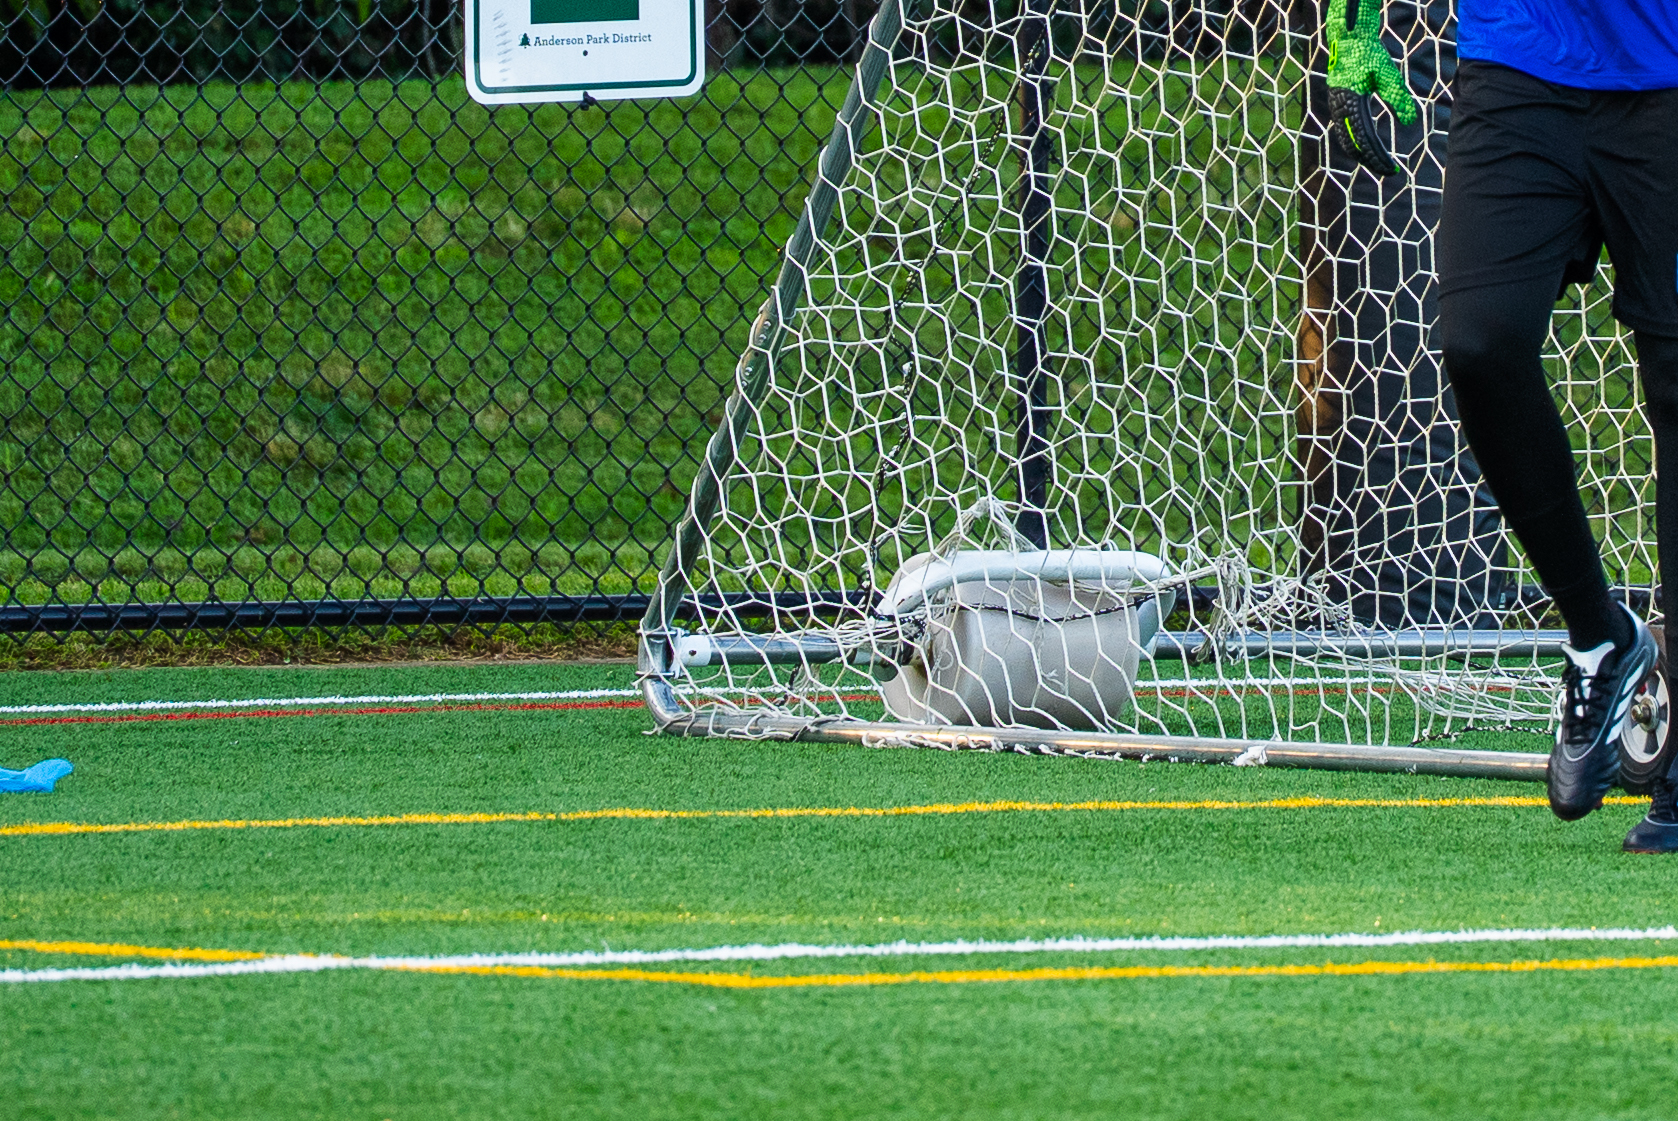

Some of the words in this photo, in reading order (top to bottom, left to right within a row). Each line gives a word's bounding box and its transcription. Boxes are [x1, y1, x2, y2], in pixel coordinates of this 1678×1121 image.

[533, 35, 584, 47] Anderson
[586, 33, 610, 44] Park
[612, 32, 652, 43] District
